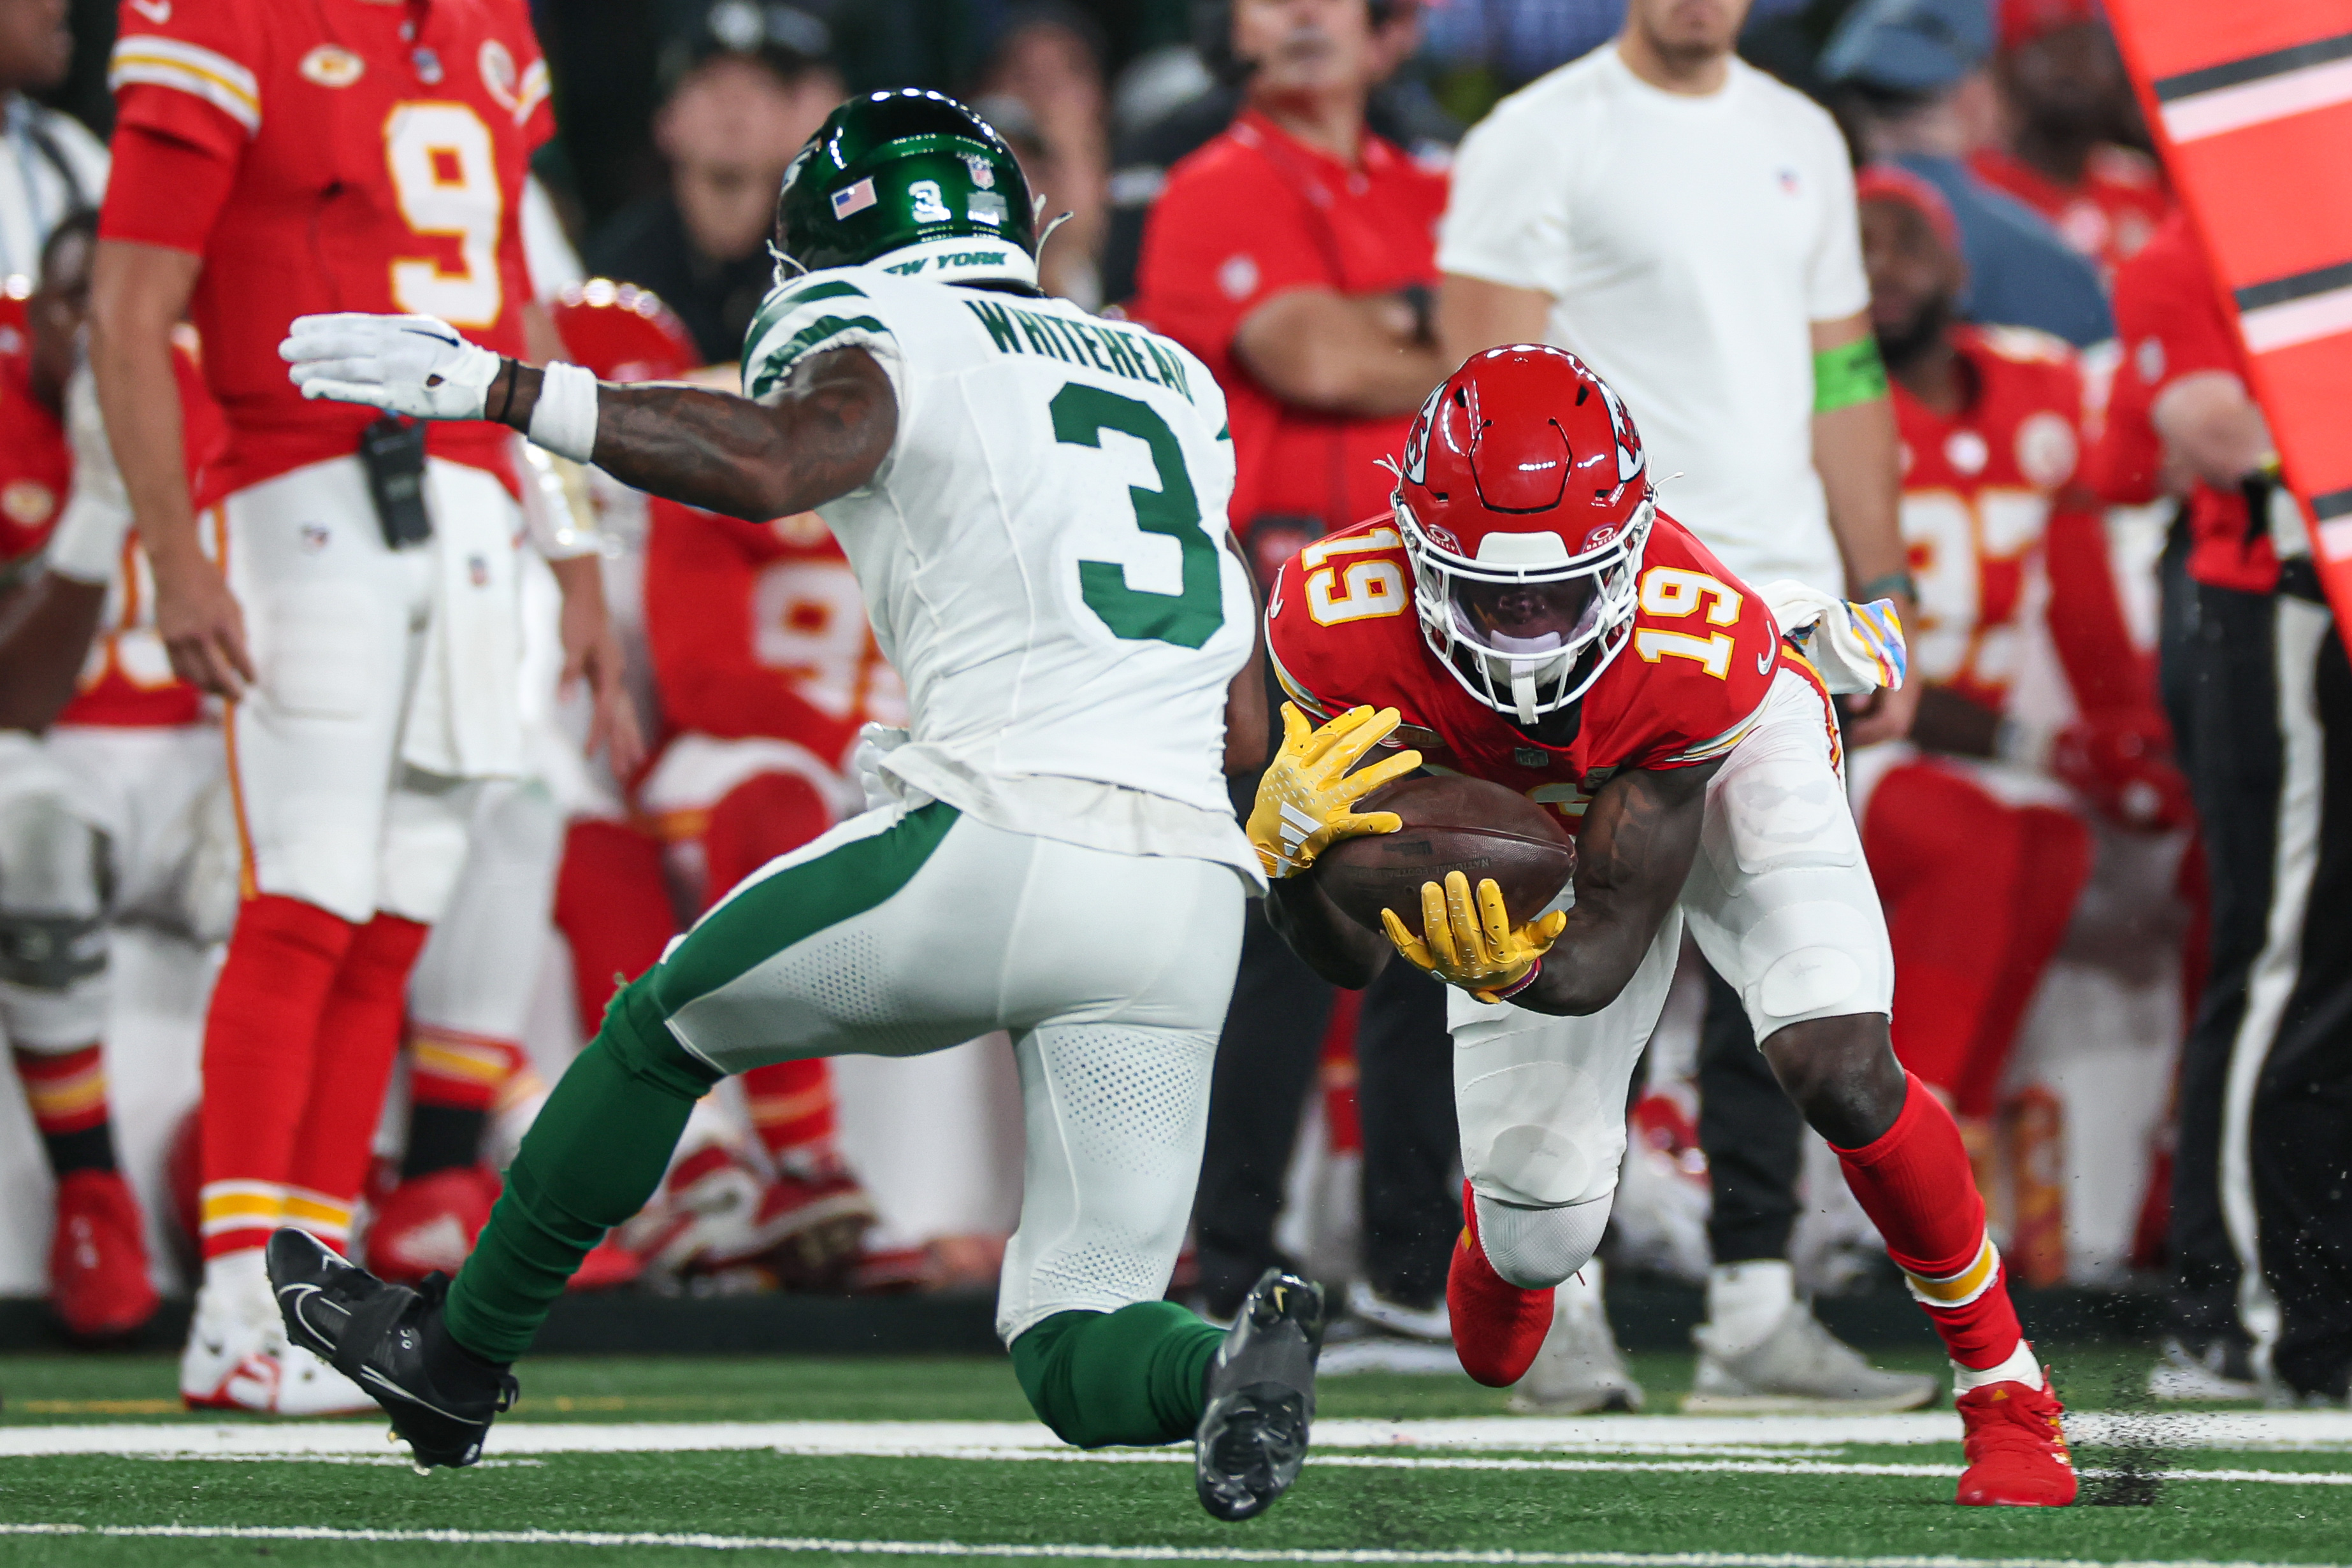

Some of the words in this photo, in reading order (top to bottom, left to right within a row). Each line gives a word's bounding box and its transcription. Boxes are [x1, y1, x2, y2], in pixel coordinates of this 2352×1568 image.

[383, 99, 503, 329] 9
[907, 178, 952, 224] 3
[937, 252, 1007, 270] YORK
[963, 299, 1195, 408] WHITEHEAD
[1050, 381, 1225, 651] 3
[1426, 531, 1457, 552] OAKLEY
[1585, 530, 1619, 550] OAKLEY
[1301, 527, 1410, 628] 19
[1634, 565, 1744, 681] 19
[747, 557, 911, 730] 9
